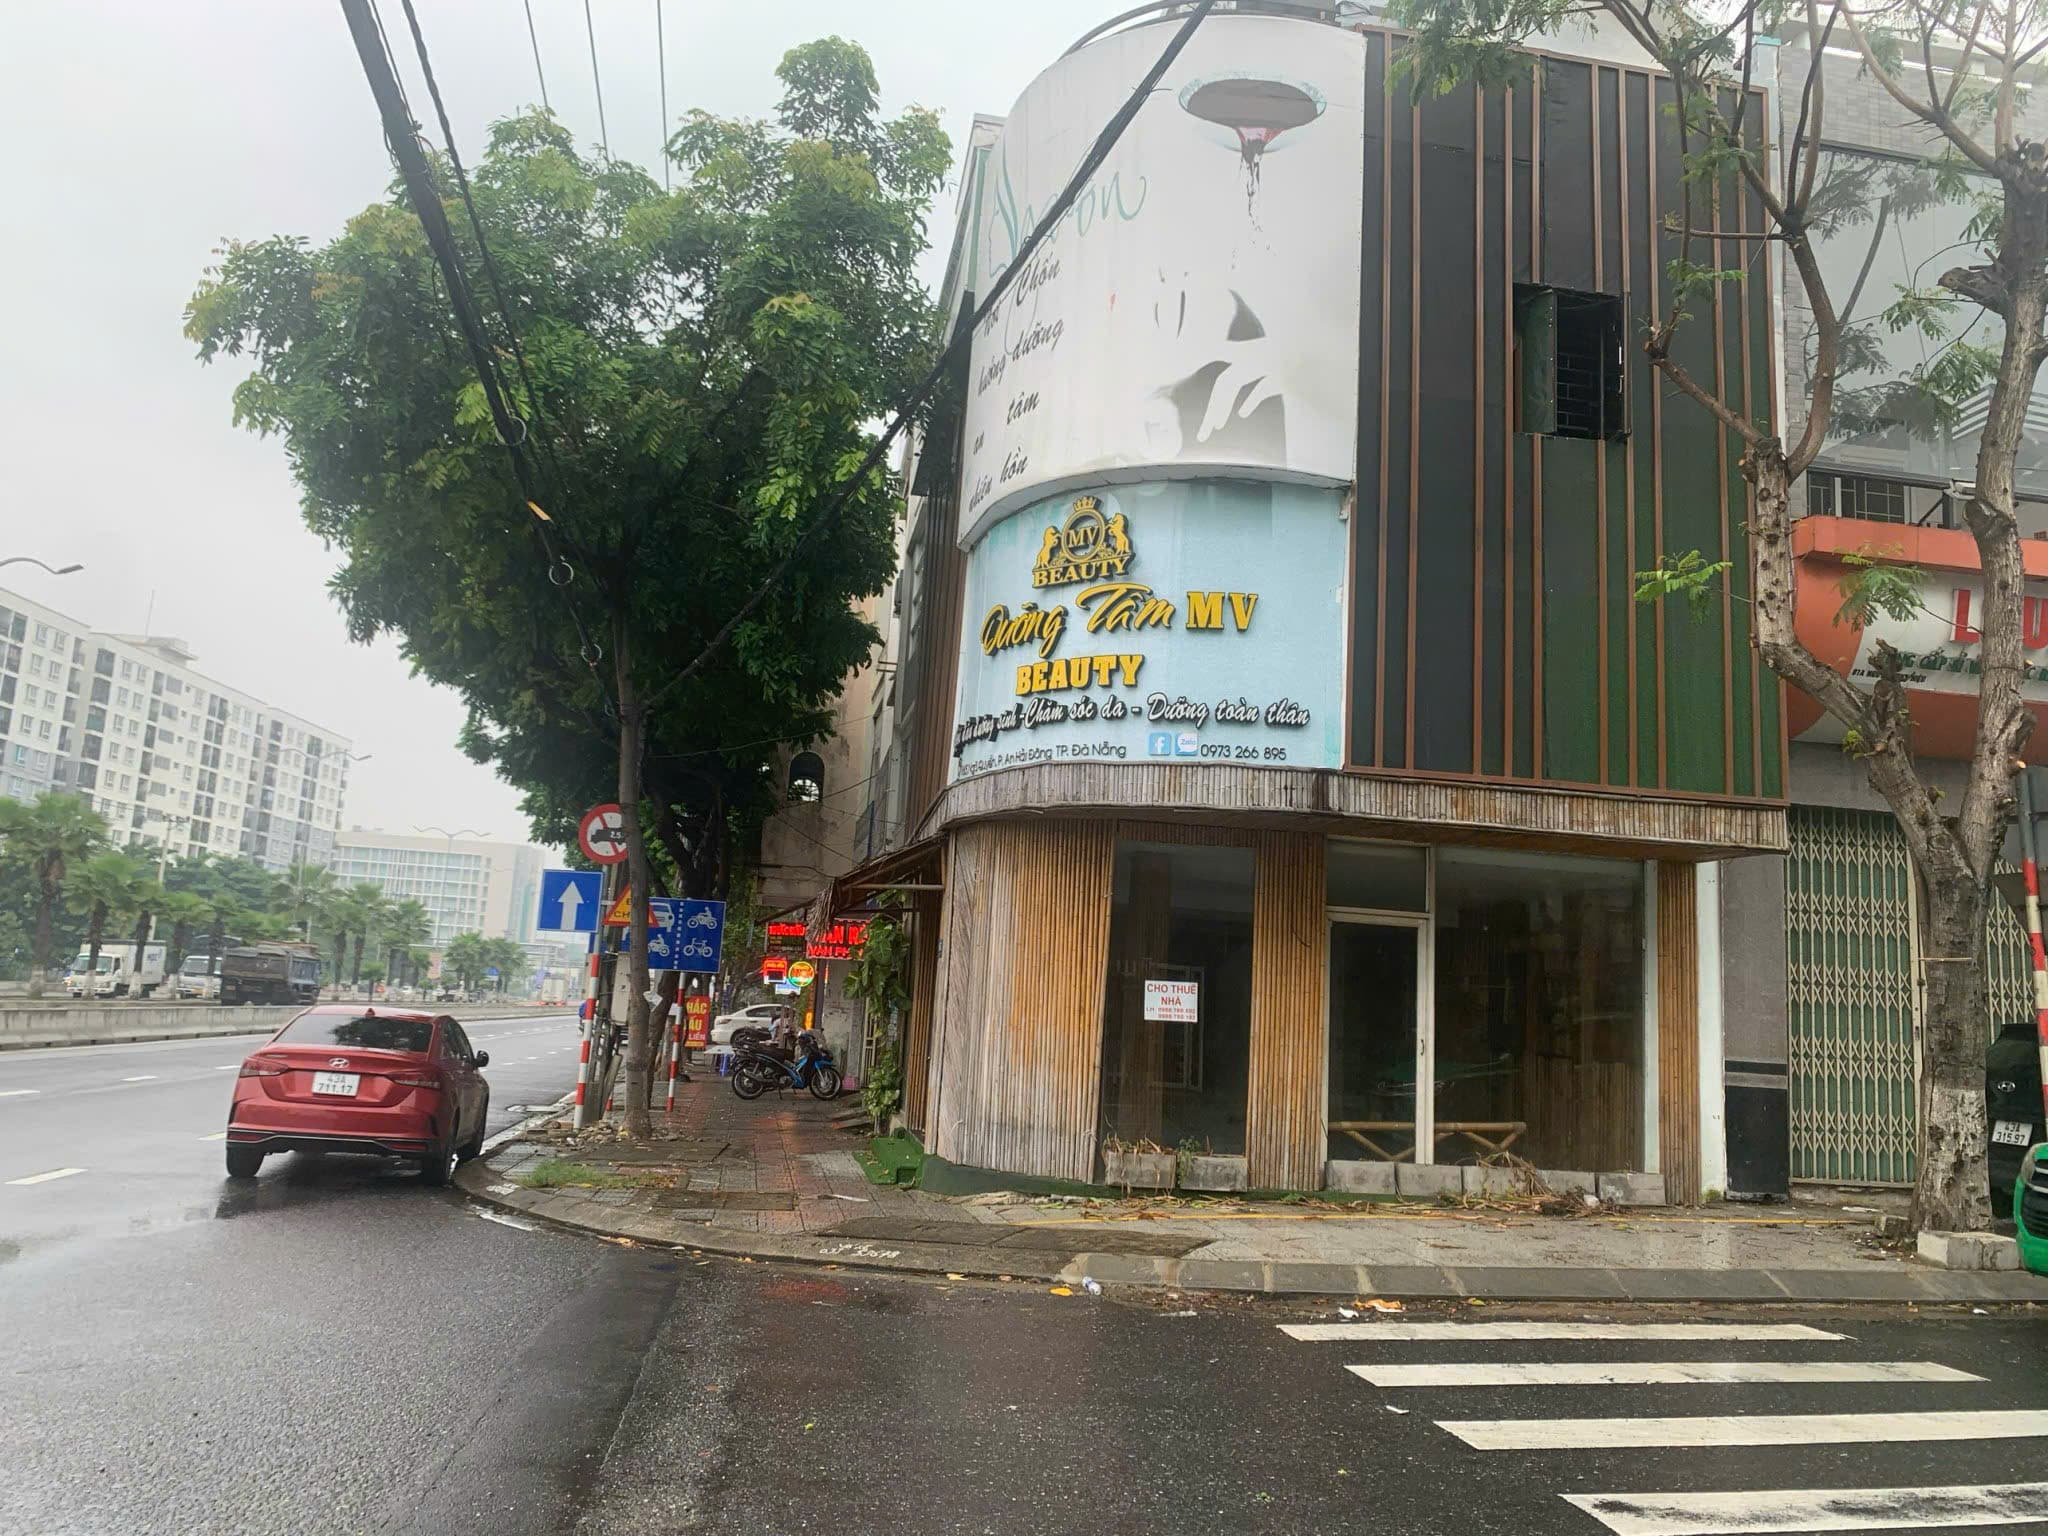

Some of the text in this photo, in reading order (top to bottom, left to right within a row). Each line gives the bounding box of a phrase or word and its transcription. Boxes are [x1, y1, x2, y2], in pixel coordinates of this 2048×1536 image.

[1000, 252, 1064, 485] Chốn dưỡng tâm hồn
[1068, 525, 1099, 548] MV
[1032, 556, 1130, 588] BEAUTY
[1075, 582, 1177, 634] Tâm
[1186, 591, 1259, 633] MV
[1015, 654, 1145, 697] BEAUTY
[1025, 697, 1068, 730] Chăm
[1069, 695, 1097, 722] sóc
[1101, 694, 1128, 721] da
[1147, 691, 1209, 729] Dưỡng
[1215, 697, 1259, 724] toàn
[1264, 698, 1311, 728] thân
[1072, 743, 1090, 757] Đà
[1092, 741, 1127, 759] Nẵng
[1200, 744, 1287, 761] 0973 266 895
[1147, 983, 1196, 994] CHO THUÊ
[1161, 996, 1181, 1006] NHÀ
[318, 1082, 353, 1094] 711.17
[1996, 1131, 2026, 1145] 315.97
